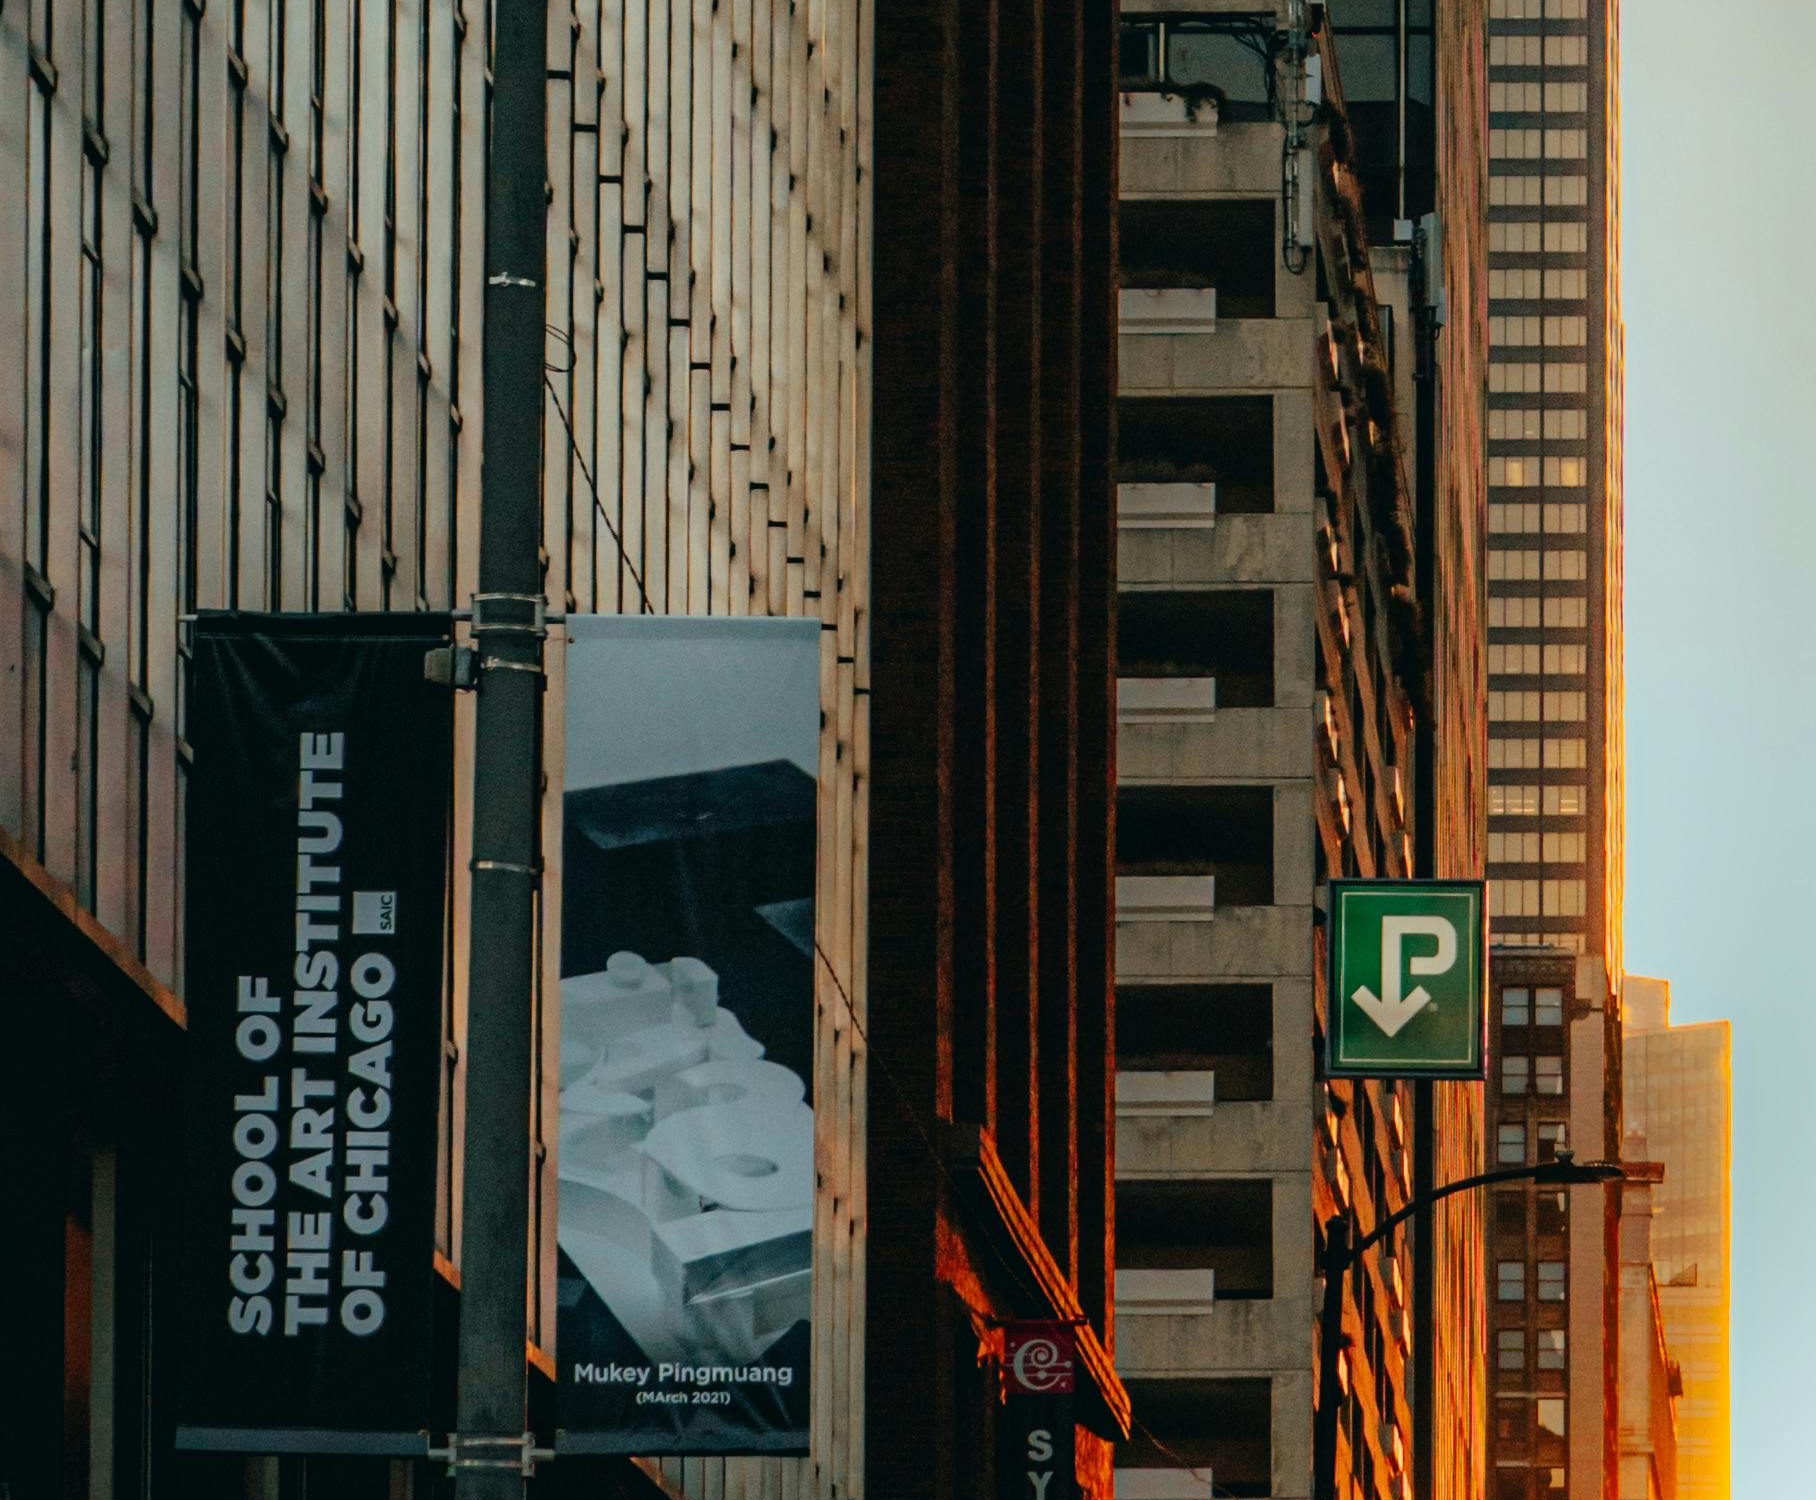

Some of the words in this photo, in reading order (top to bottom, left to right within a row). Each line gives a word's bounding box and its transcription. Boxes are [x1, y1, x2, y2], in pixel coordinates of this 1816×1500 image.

[292, 731, 345, 1057] INSTITUTE
[379, 892, 394, 932] SAIC
[235, 975, 282, 1062] OF
[1351, 915, 1457, 1038] P
[289, 1077, 335, 1195] ART
[344, 952, 396, 1235] CHICAGO
[228, 1077, 280, 1336] SCHOOL
[285, 1209, 331, 1336] THE
[341, 1249, 387, 1336] OF
[574, 1361, 652, 1388] Mukey
[658, 1361, 793, 1388] Pingmuang
[636, 1390, 688, 1405] (MArch
[692, 1390, 731, 1405] 2021)
